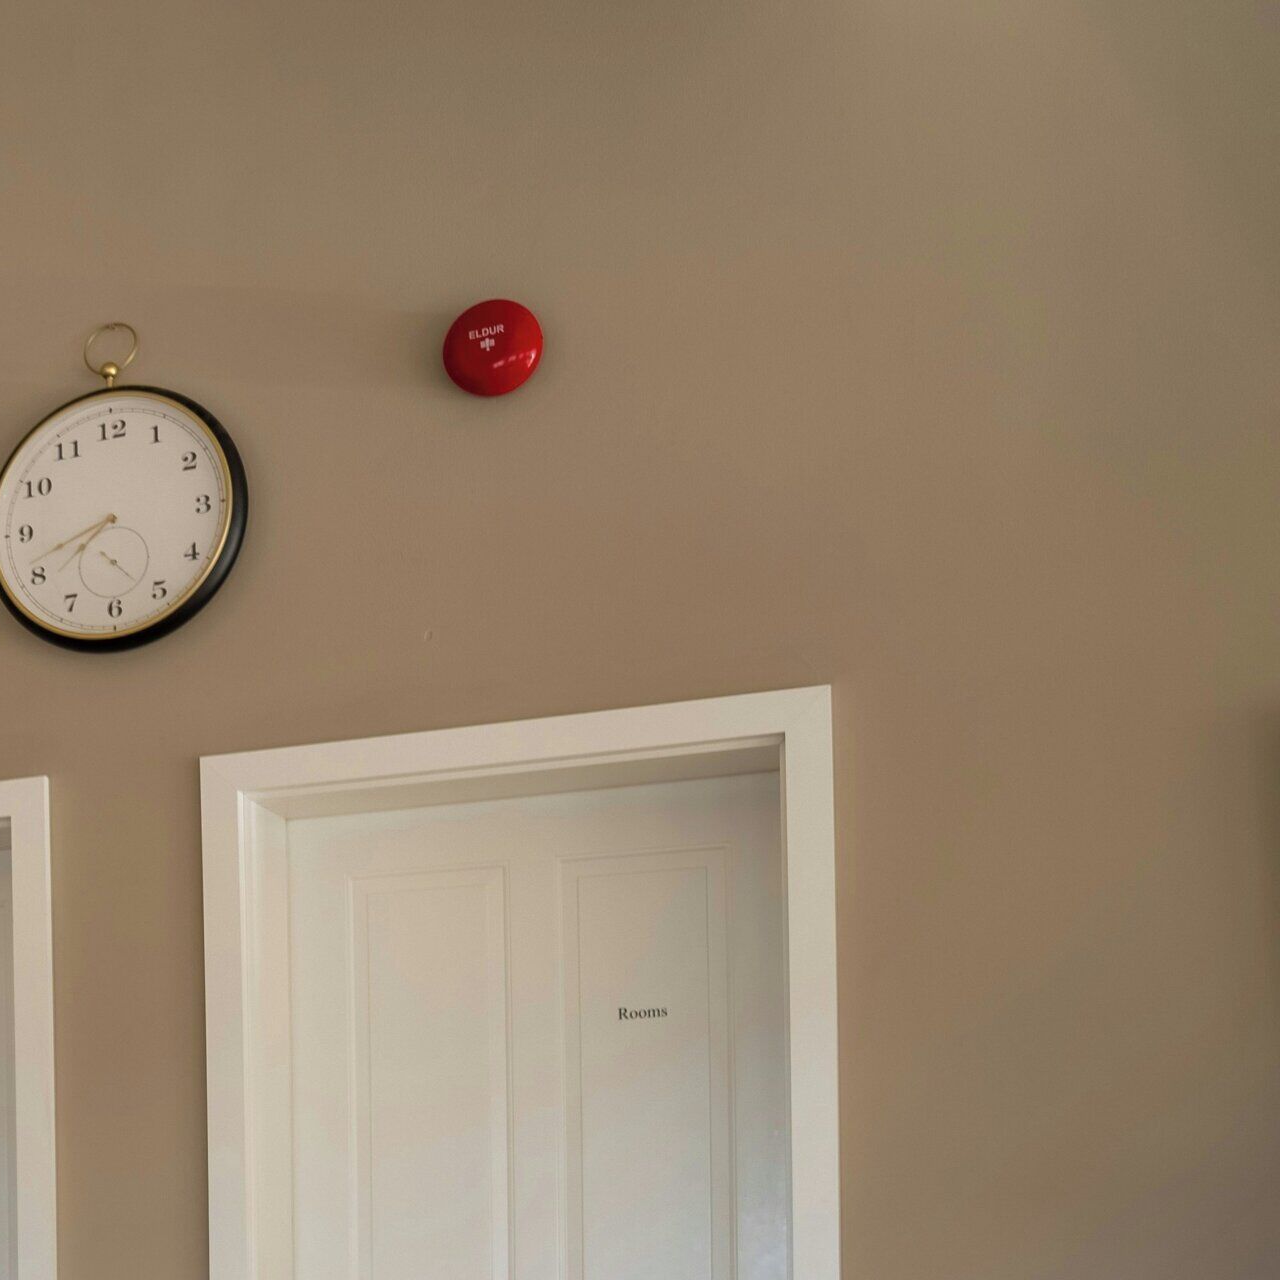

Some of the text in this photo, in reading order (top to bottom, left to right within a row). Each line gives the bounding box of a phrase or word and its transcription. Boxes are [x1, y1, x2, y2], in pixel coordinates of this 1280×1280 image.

[468, 324, 504, 340] ELDUR
[97, 418, 127, 442] 12
[149, 425, 162, 444] 1
[54, 440, 81, 462] 11
[182, 451, 197, 472] 2
[24, 477, 52, 499] 10
[195, 494, 212, 515] 3
[19, 524, 34, 544] 9
[184, 541, 200, 561] 4
[31, 566, 46, 587] 8
[152, 579, 167, 601] 5
[64, 593, 79, 613] 7
[107, 599, 123, 618] 6
[618, 1007, 668, 1021] Rooms
